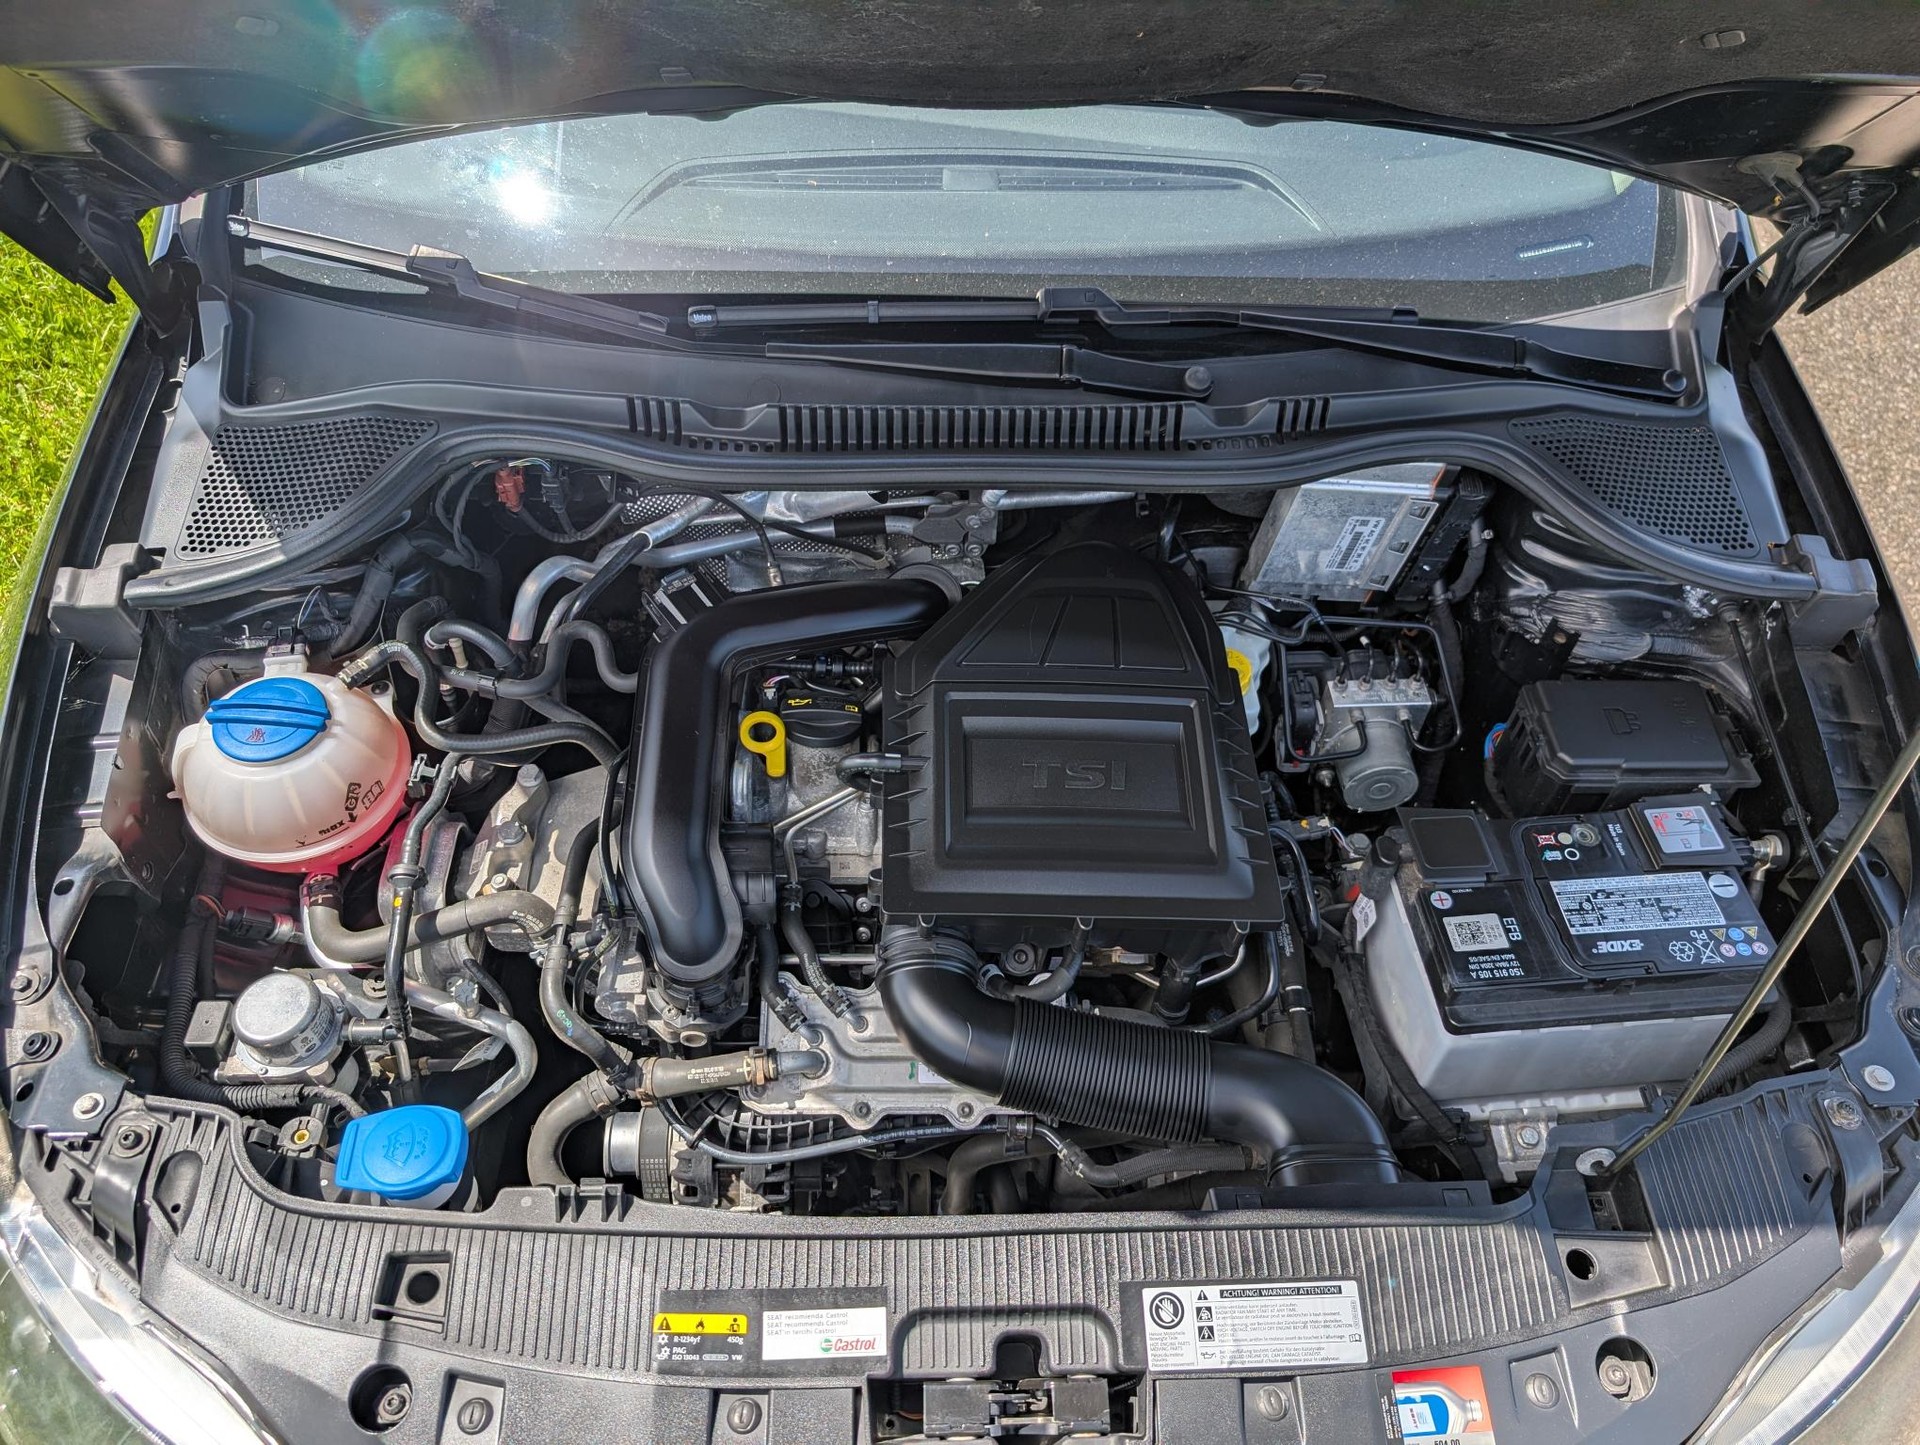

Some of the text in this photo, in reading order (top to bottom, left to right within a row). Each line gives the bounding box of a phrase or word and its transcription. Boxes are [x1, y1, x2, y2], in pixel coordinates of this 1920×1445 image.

[693, 313, 712, 323] Valeo
[1022, 760, 1126, 790] TSI
[318, 820, 346, 836] max
[1503, 918, 1521, 940] EFB
[1690, 930, 1708, 939] Pb
[1597, 939, 1641, 952] EXIDE
[1478, 970, 1493, 978] 105
[1494, 969, 1508, 977] 915
[1509, 968, 1524, 976] 1S0
[1222, 1286, 1340, 1297] ACHTUNG! WARNING! ATTENTION!
[673, 1336, 744, 1345] R-1234yf 450g
[834, 1337, 876, 1351] Castrol
